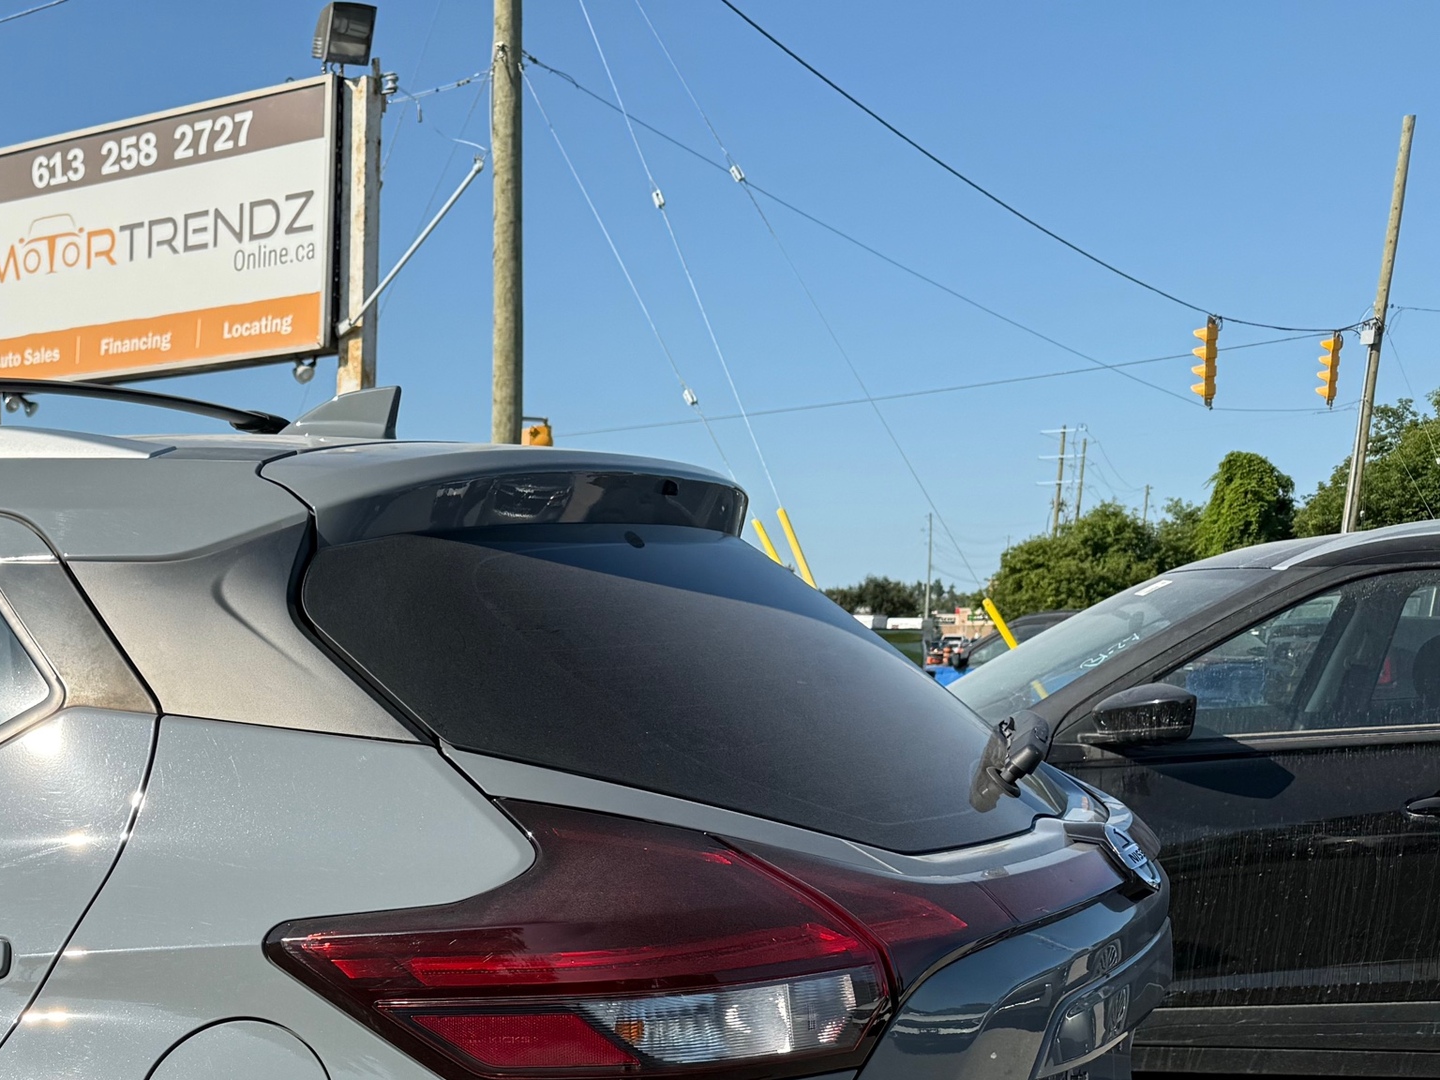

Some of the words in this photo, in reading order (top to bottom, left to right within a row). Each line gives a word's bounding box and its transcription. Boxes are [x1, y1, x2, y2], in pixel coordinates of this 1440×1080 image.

[31, 147, 85, 188] 613
[100, 132, 158, 175] 258
[173, 110, 253, 160] 2727
[233, 241, 315, 272] Online.ca
[222, 314, 293, 340] Locating
[24, 346, 60, 366] Sales
[100, 331, 172, 356] Financing
